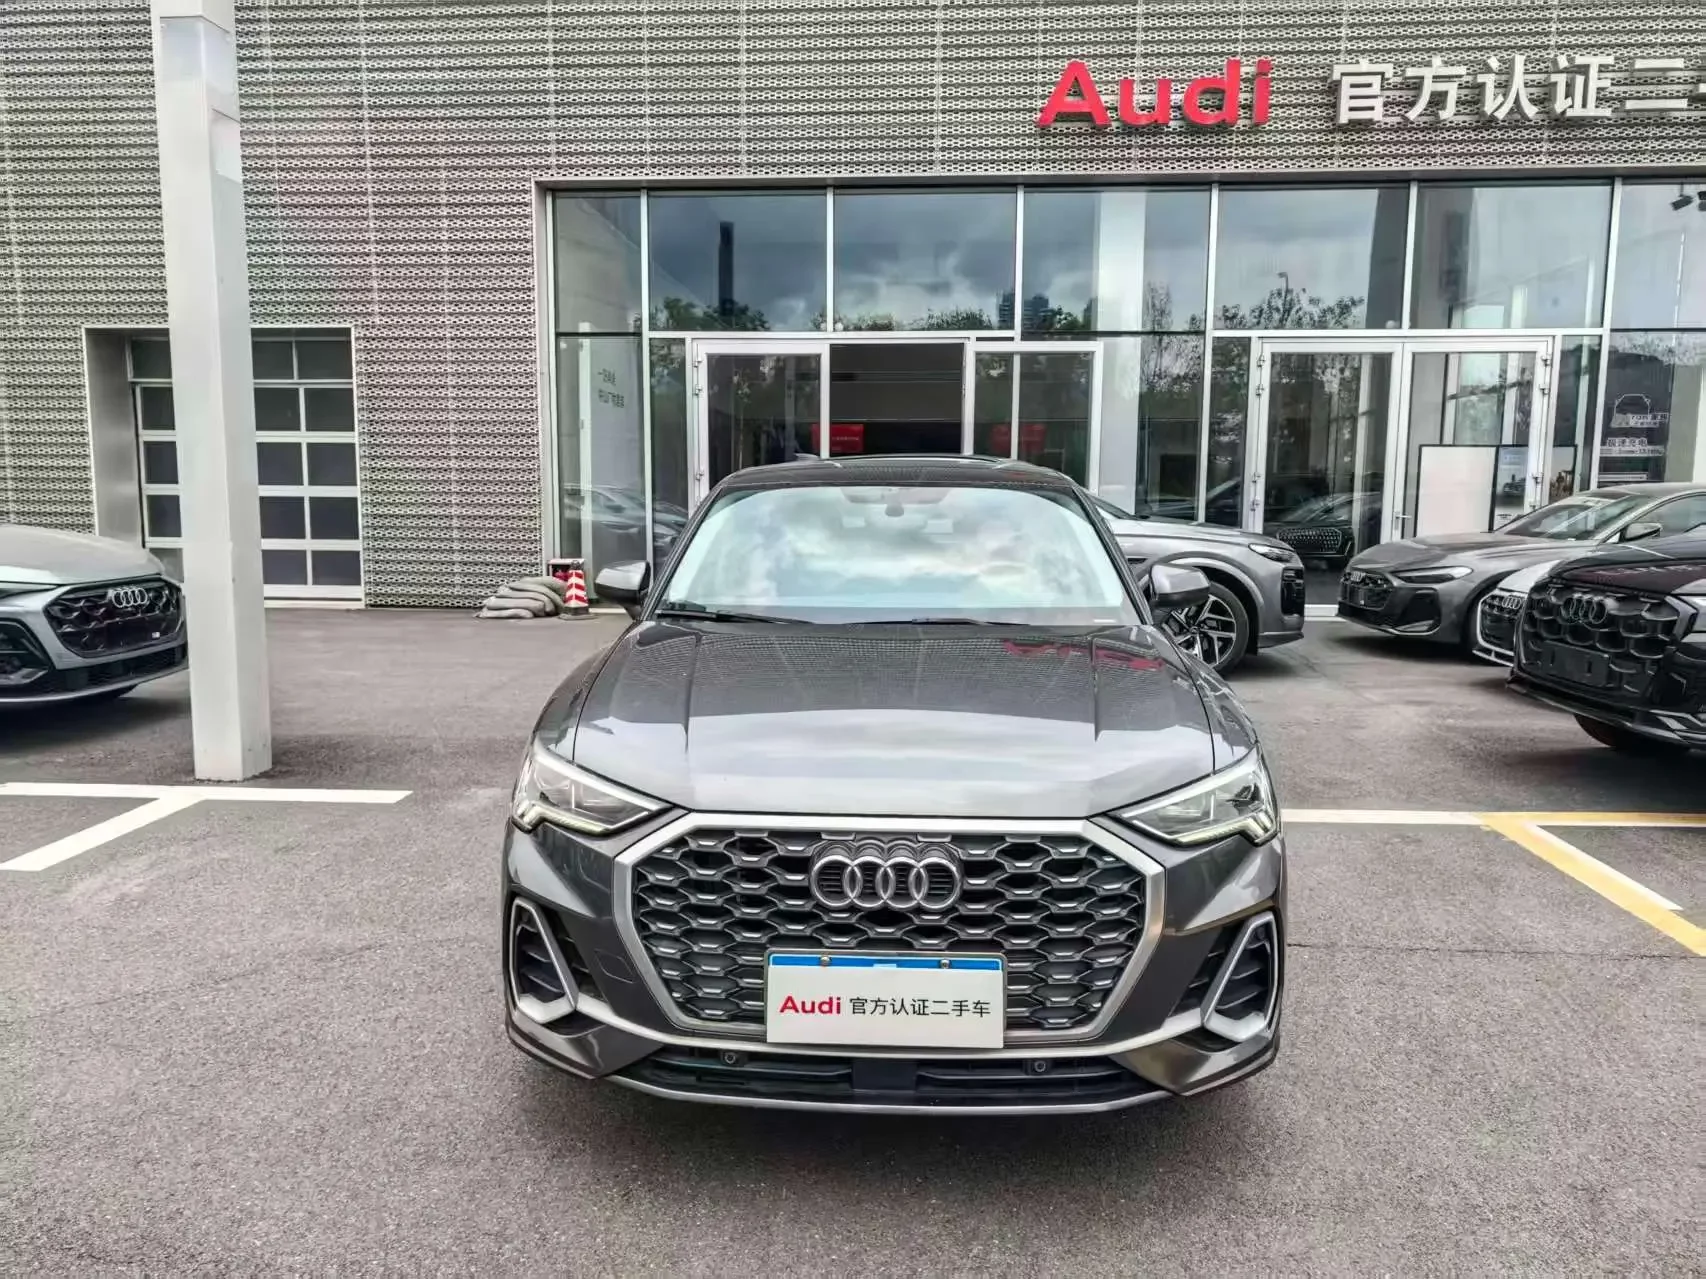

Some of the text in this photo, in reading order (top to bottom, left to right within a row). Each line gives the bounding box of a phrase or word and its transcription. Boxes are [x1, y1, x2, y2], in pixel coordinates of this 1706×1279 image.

[1037, 55, 1706, 128] Audi 官方认证二
[779, 995, 991, 1018] Audi 官方认证二手车
